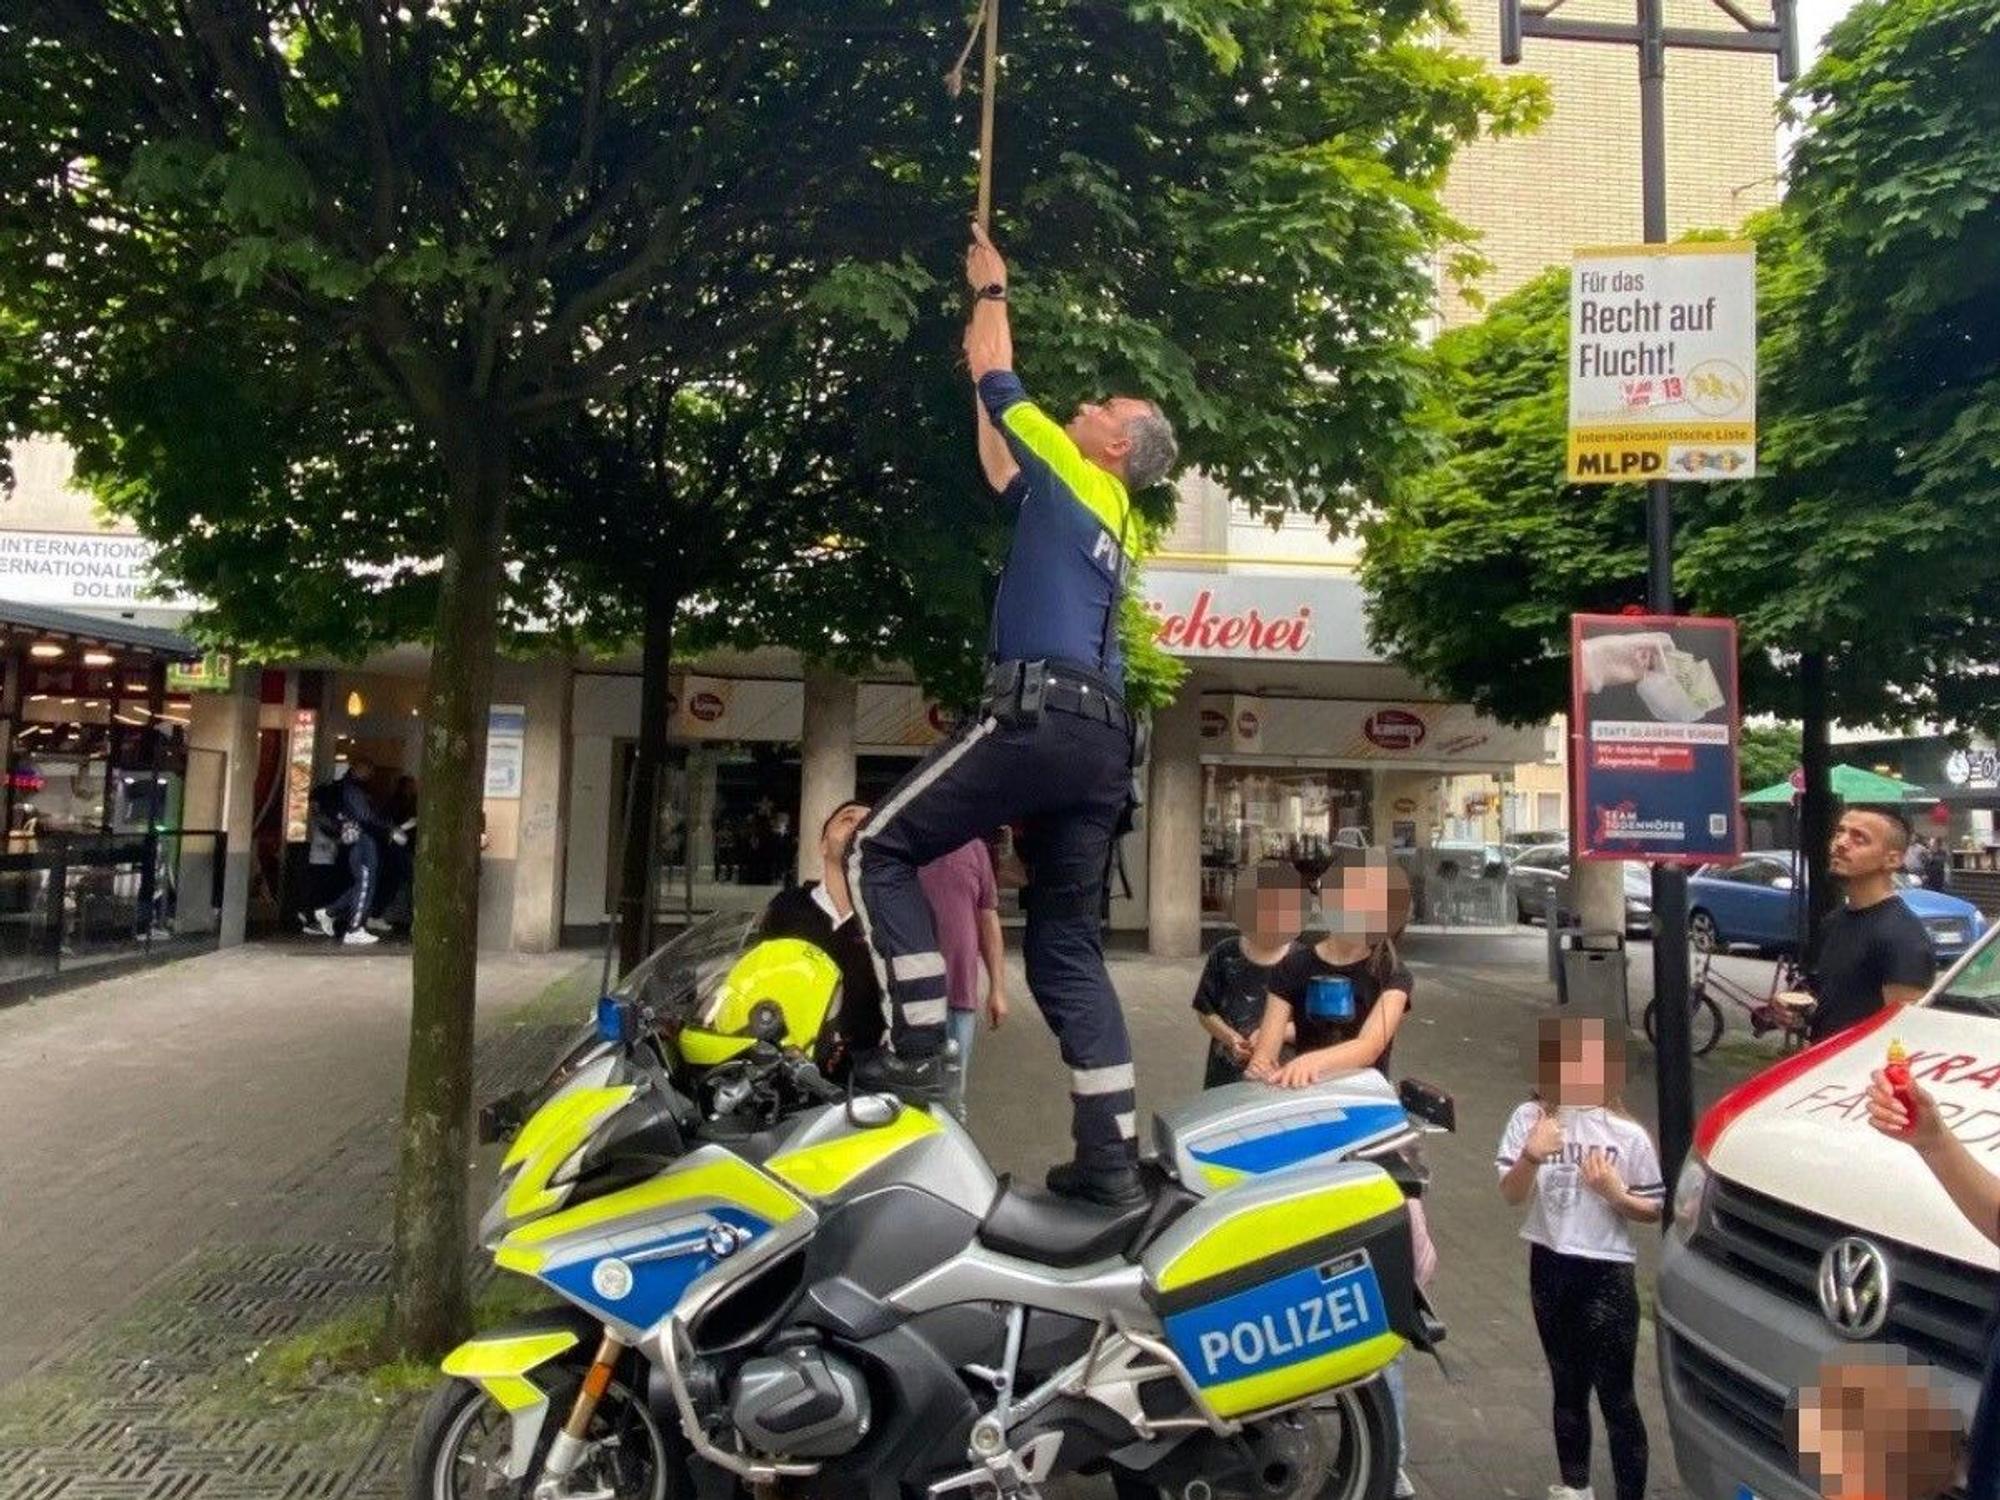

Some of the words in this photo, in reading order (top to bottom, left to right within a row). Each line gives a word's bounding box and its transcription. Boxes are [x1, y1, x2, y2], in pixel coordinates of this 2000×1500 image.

[1580, 271, 1607, 293] Für
[1612, 270, 1644, 292] das
[1579, 298, 1662, 334] Recht
[1669, 296, 1716, 331] auf
[1578, 341, 1675, 377] Flucht!
[1661, 377, 1683, 398] 13
[1716, 428, 1747, 441] Liste
[1576, 451, 1662, 476] MLPD
[1146, 591, 1312, 650] ckerei
[1200, 1281, 1370, 1375] POLIZEI
